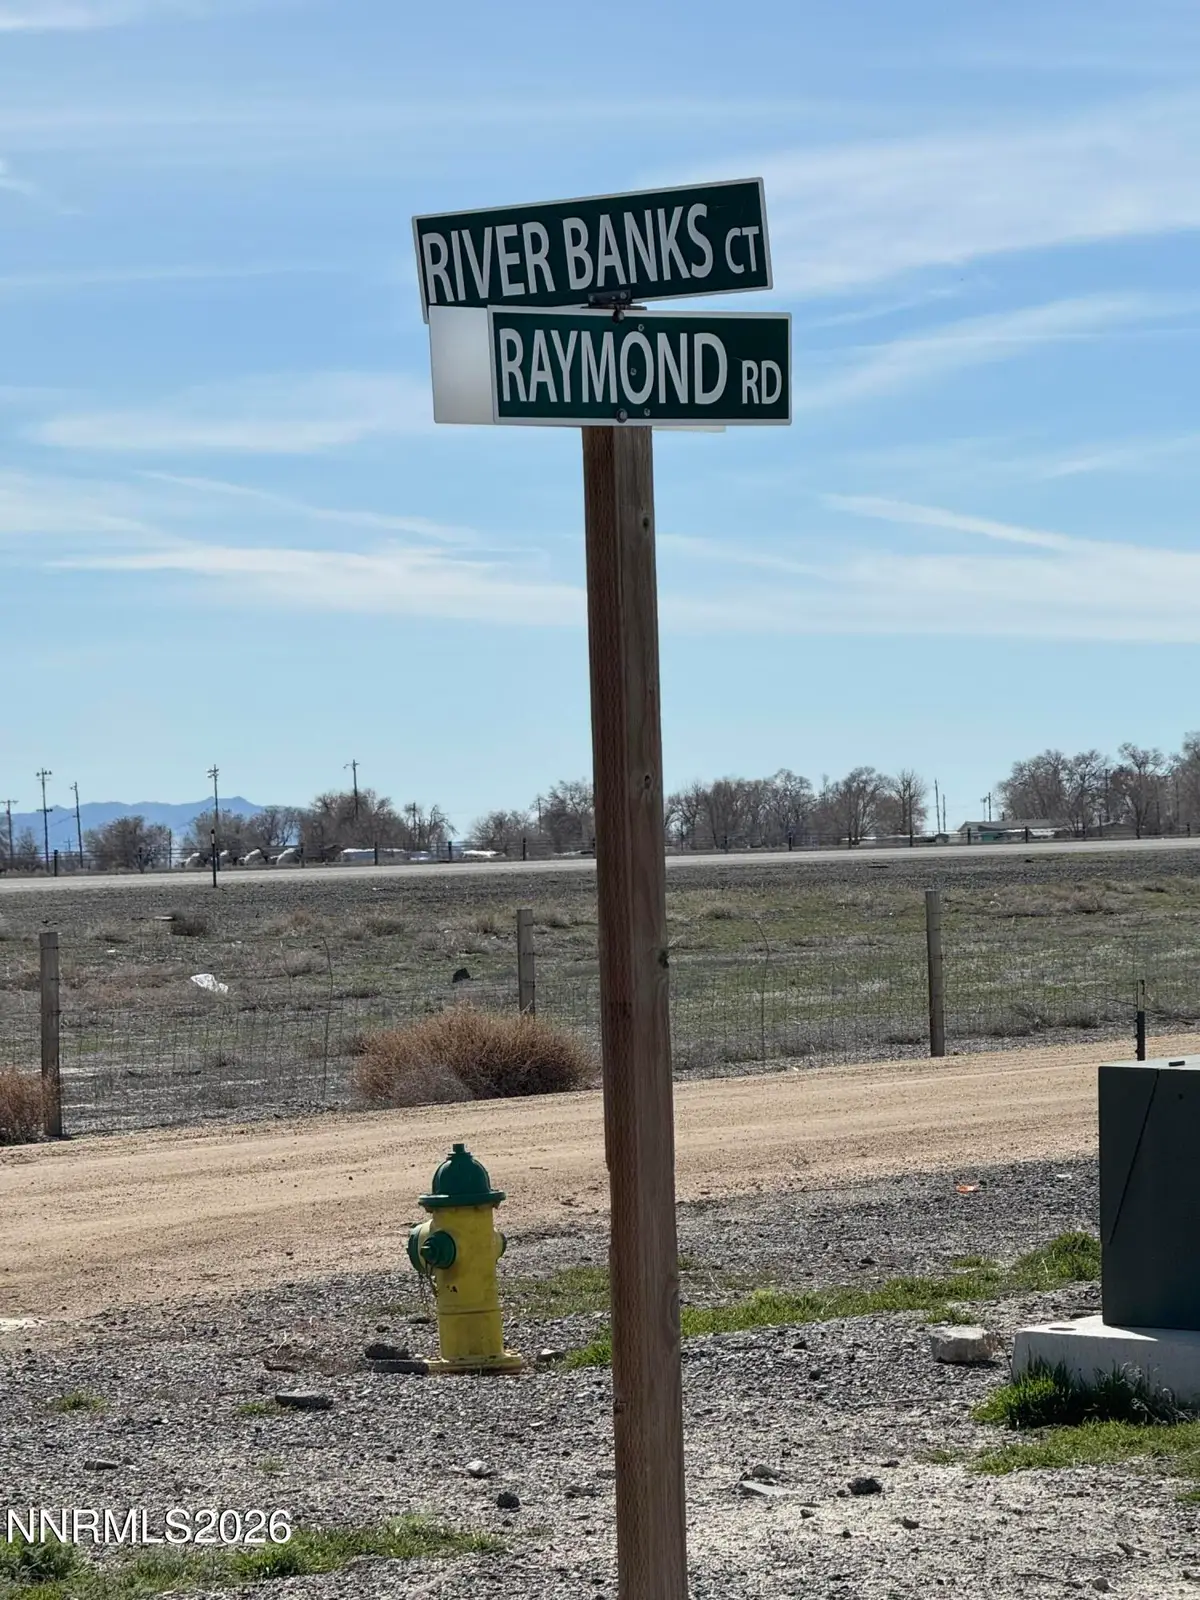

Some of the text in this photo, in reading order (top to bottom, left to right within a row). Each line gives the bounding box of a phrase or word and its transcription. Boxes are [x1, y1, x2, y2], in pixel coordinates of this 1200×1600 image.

[422, 203, 760, 304] RIVER BANKS CT
[499, 328, 783, 405] RAYMOND RD
